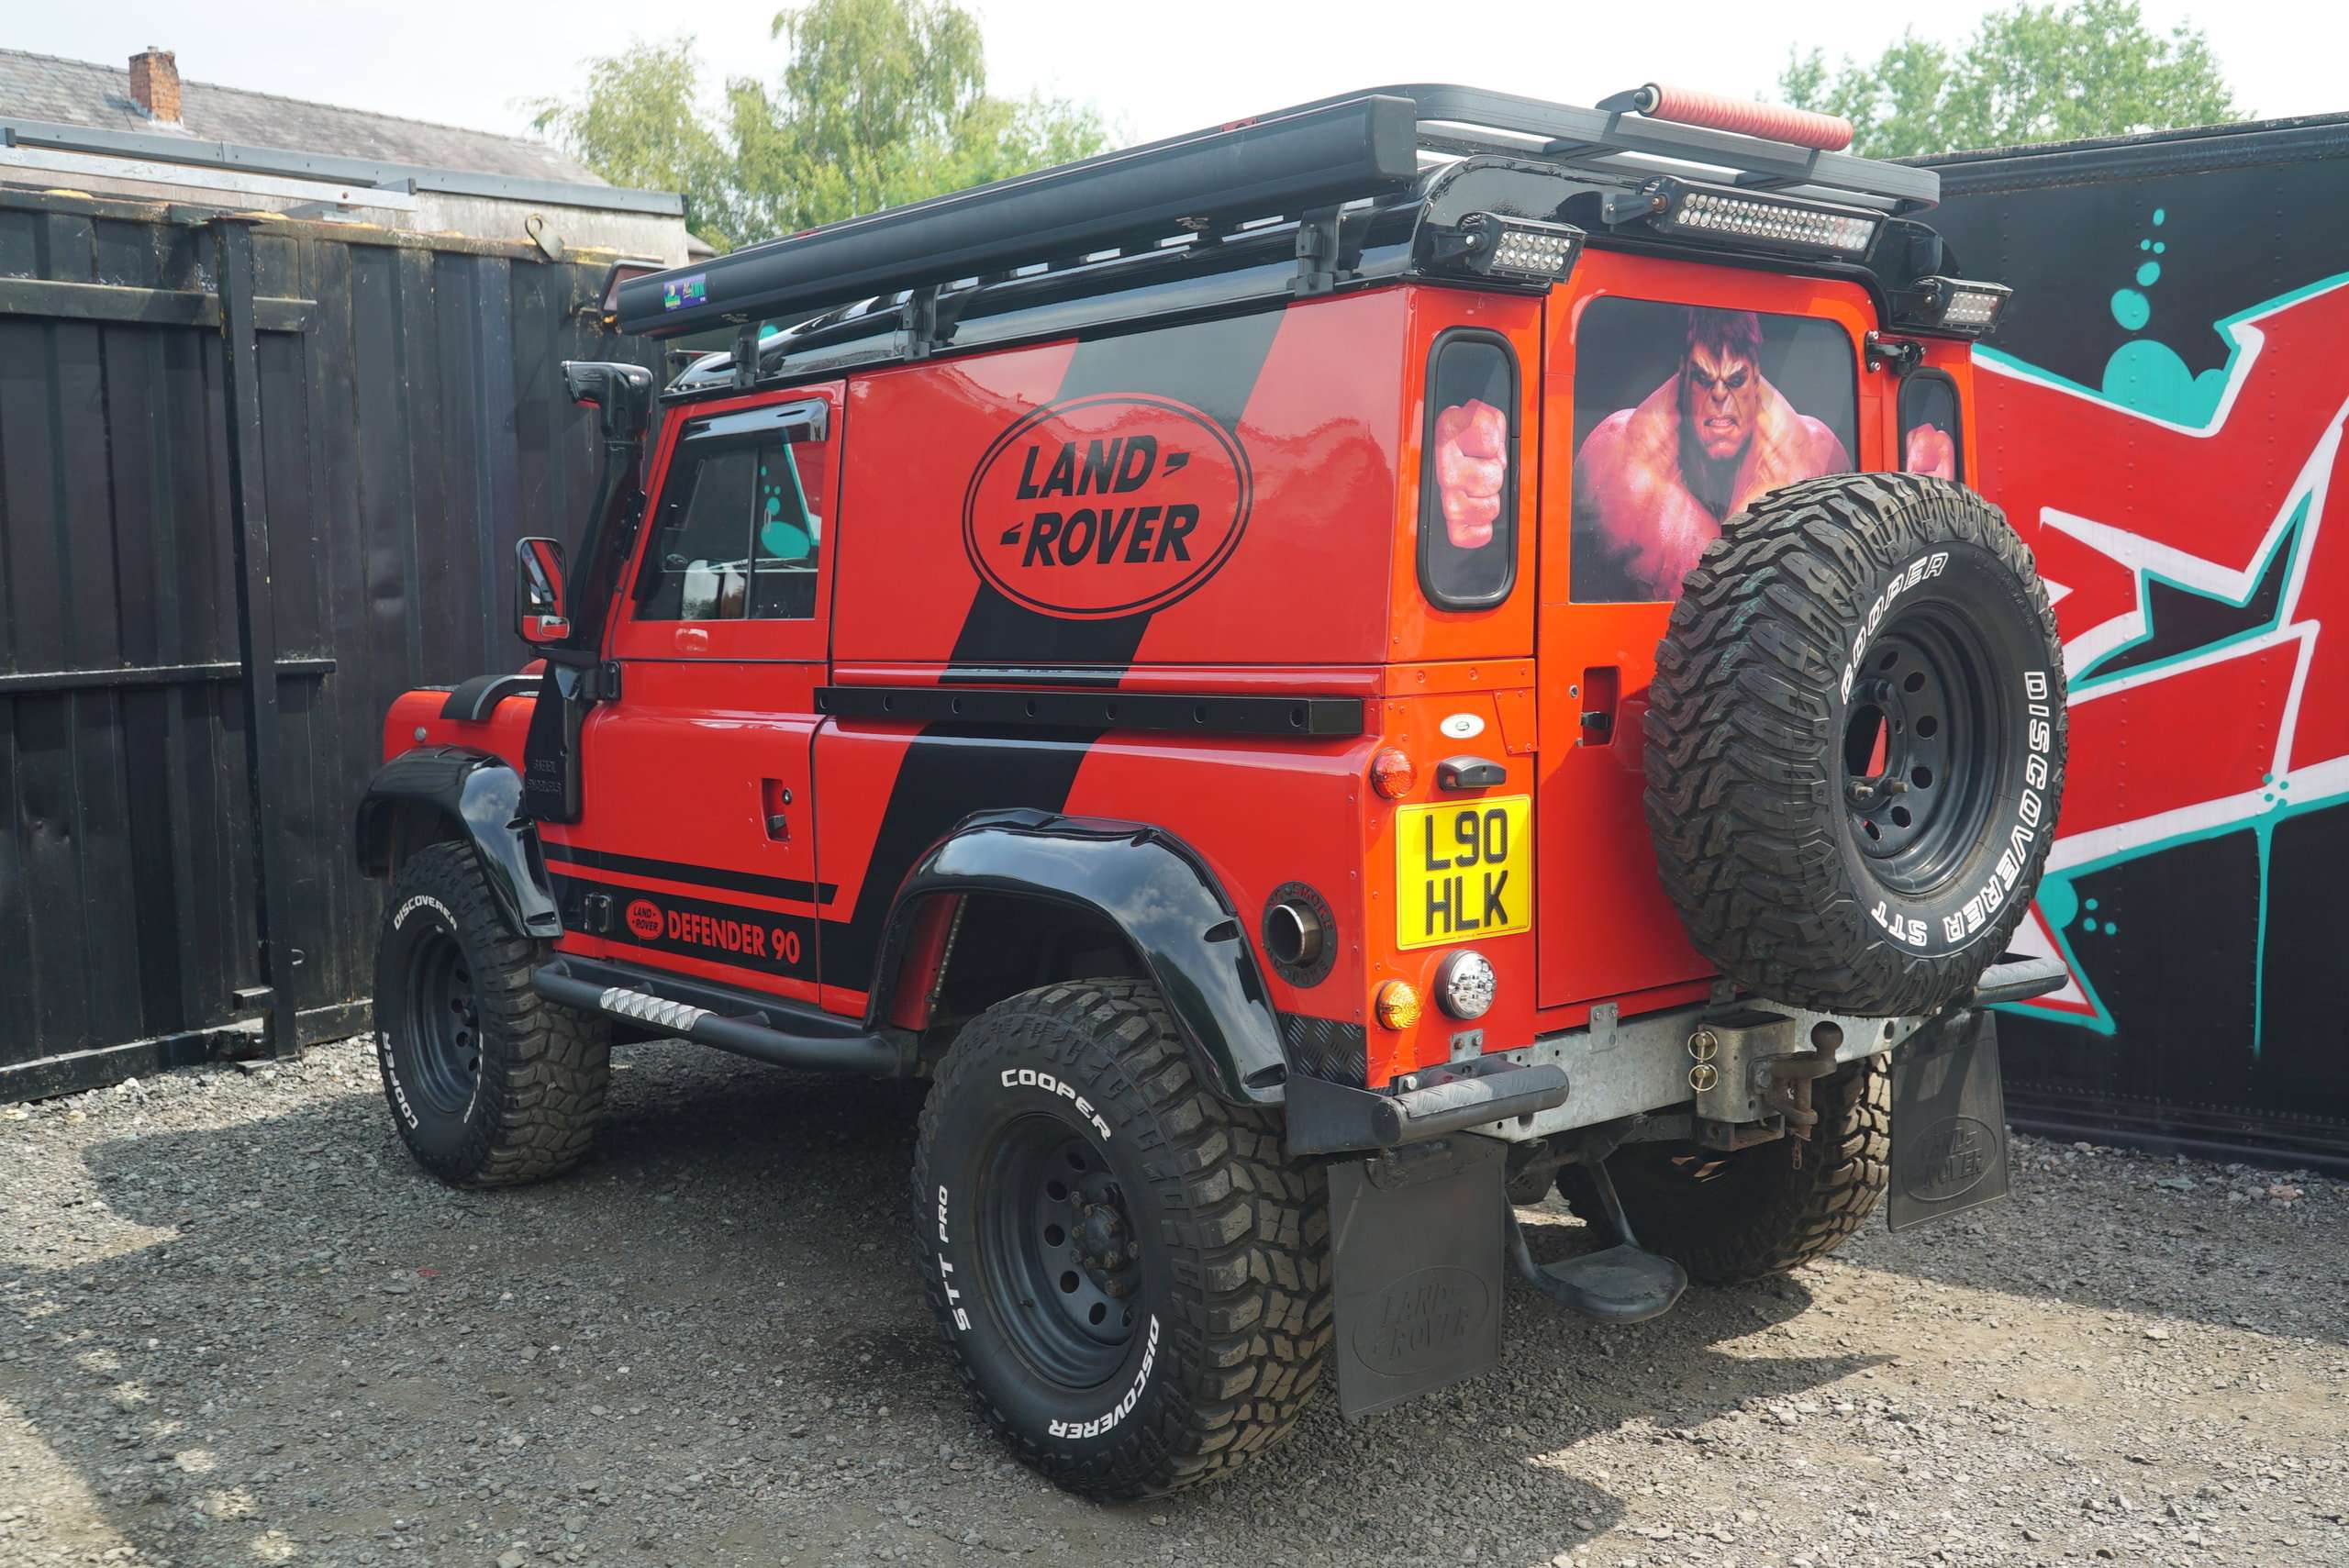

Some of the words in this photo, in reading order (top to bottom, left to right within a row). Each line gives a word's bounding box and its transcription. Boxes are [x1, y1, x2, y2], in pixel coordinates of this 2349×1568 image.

[1016, 435, 1158, 500] LAND
[1021, 504, 1200, 567] ROVER
[1841, 552, 1948, 705] COOPER
[1425, 807, 1508, 872] L90
[1943, 672, 2051, 944] DISCOVERER
[393, 894, 458, 932] DISCOVERER
[633, 906, 652, 918] LAND
[636, 918, 659, 932] ROVER
[1425, 870, 1508, 936] HLK
[1871, 900, 1928, 947] STT
[668, 909, 767, 958] DEFENDER
[771, 928, 801, 964] 90
[381, 1030, 419, 1130] COOPER
[1000, 1068, 1113, 1142] COOPER
[938, 1184, 950, 1244] PRO
[938, 1252, 972, 1332] STT
[1048, 1313, 1161, 1440] DISCOVERER
